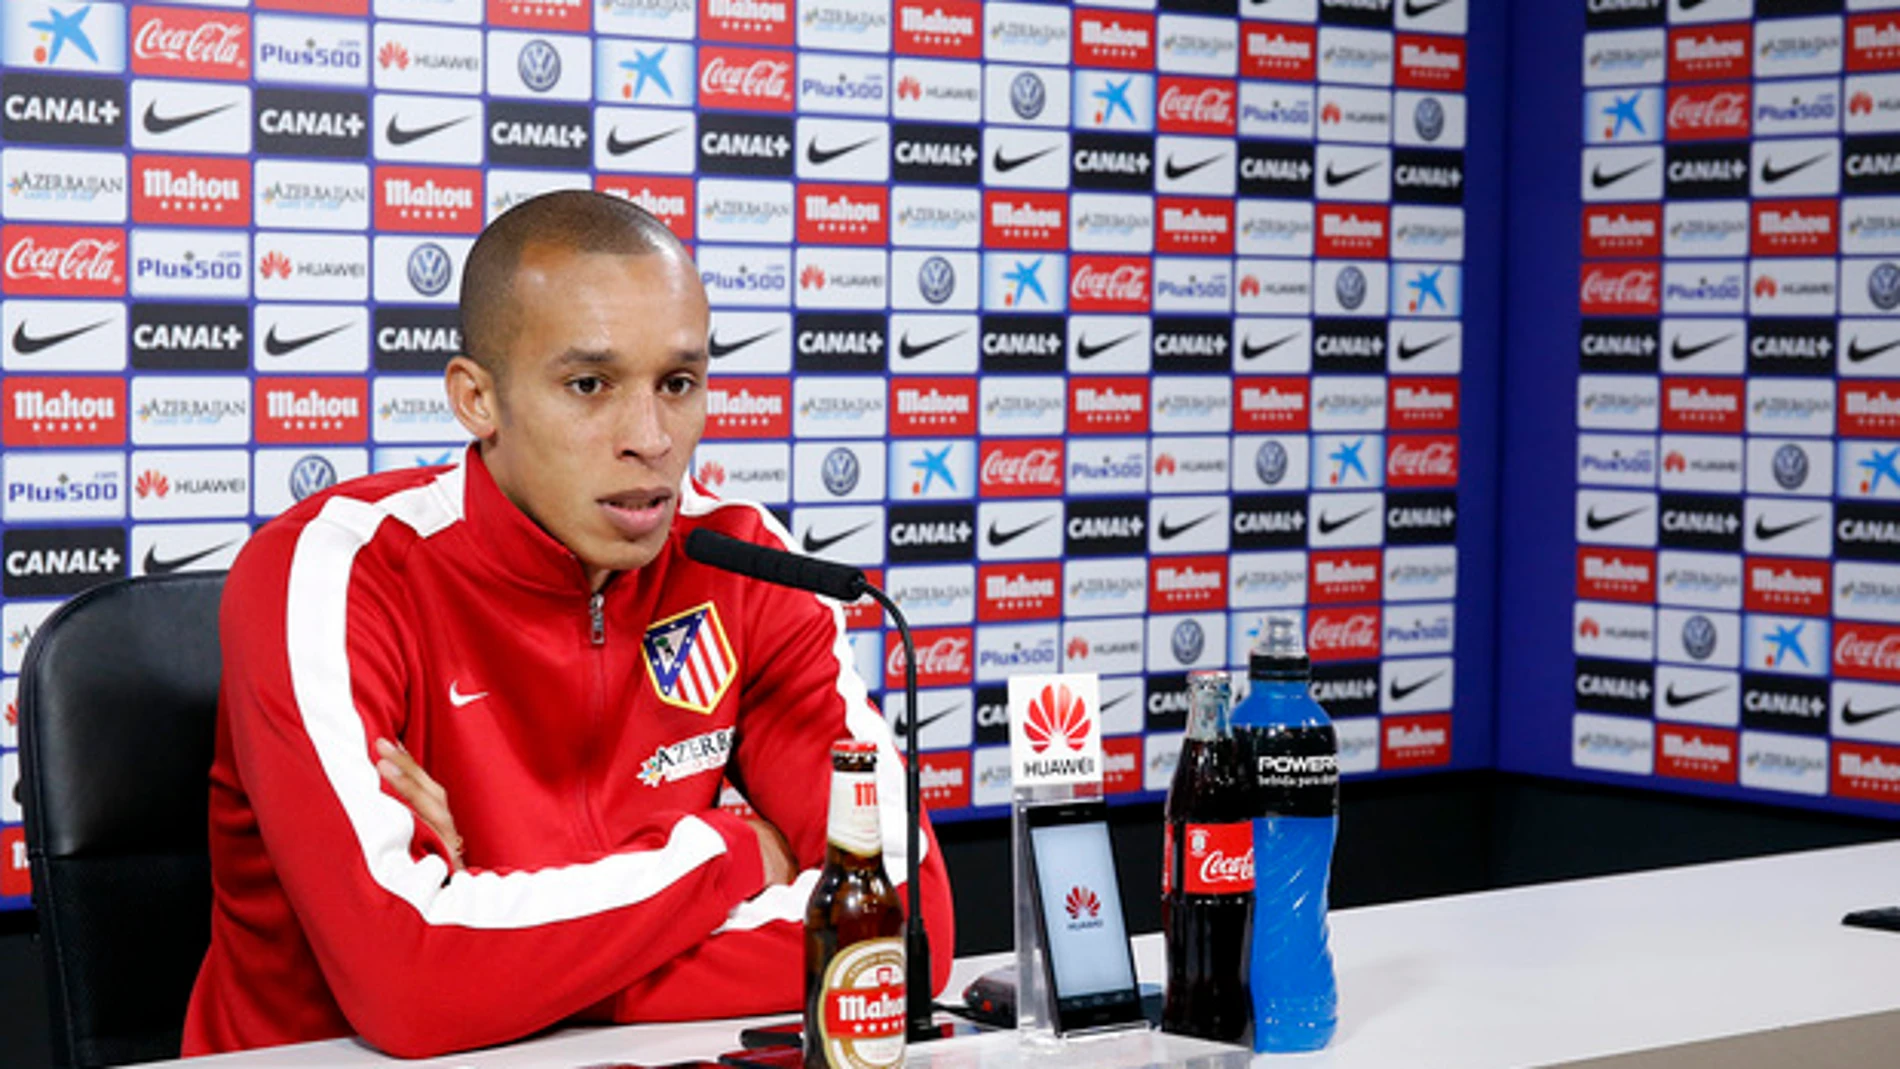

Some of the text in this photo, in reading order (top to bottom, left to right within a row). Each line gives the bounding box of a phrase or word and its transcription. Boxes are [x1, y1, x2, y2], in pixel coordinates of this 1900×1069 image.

[903, 8, 973, 35] Mahou
[134, 18, 245, 64] Coca-Cola
[260, 44, 361, 68] Plus500
[414, 53, 478, 70] HUAWEI
[700, 57, 787, 97] Coca-Cola
[802, 79, 884, 100] Plus500
[5, 95, 120, 124] CANAL+
[260, 110, 364, 136] CANAL+
[491, 122, 587, 147] CANAL+
[702, 132, 790, 157] CANAL+
[895, 142, 977, 165] CANAL+
[1078, 150, 1151, 174] CANAL+
[1240, 158, 1311, 180] CANAL+
[1668, 160, 1746, 181] CANAL+
[21, 171, 123, 195] AZERBAIJAN
[143, 169, 240, 200] Mahou
[1395, 165, 1461, 186] CANAL+
[272, 181, 365, 203] AZERBAIJAN
[385, 179, 473, 209] Mahou
[805, 195, 880, 222] Mahou
[992, 202, 1060, 228] Mahou
[5, 238, 120, 279] Coca-Cola
[138, 258, 241, 279] Plus500
[297, 262, 364, 277] HUAWEI
[702, 272, 785, 290] Plus500
[1072, 265, 1148, 299] Coca-Cola
[134, 325, 243, 349] CANAL+
[376, 327, 458, 352] CANAL
[798, 332, 883, 353] CANAL+
[982, 333, 1061, 354] CANAL+
[1154, 334, 1228, 356] CANAL+
[1315, 336, 1383, 356] CANAL+
[1581, 335, 1656, 355] CANAL+
[1751, 337, 1831, 357] CANAL+
[13, 390, 115, 418] Mahou
[150, 399, 246, 418] AZERBAIJAN
[267, 390, 358, 417] Mahou
[707, 390, 782, 413] Mahou
[898, 390, 968, 412] Mahou
[1075, 388, 1142, 412] Mahou
[981, 450, 1058, 485] Coca-Cola
[1071, 461, 1143, 479] Plus500
[8, 482, 118, 501] Plus500
[175, 480, 244, 493] HUAWEI
[1068, 517, 1143, 539] CANAL+
[1234, 512, 1304, 533] CANAL+
[1388, 508, 1454, 528] CANAL+
[1662, 511, 1739, 533] CANAL+
[890, 522, 972, 545] CANAL+
[6, 548, 120, 576] CANAL+
[986, 574, 1055, 599] Mahou
[980, 648, 1054, 667] Plus500
[1577, 675, 1650, 698] CANAL+
[1744, 691, 1824, 716] CANAL+
[655, 728, 732, 772] AZERB
[1025, 758, 1094, 778] HUAWEI
